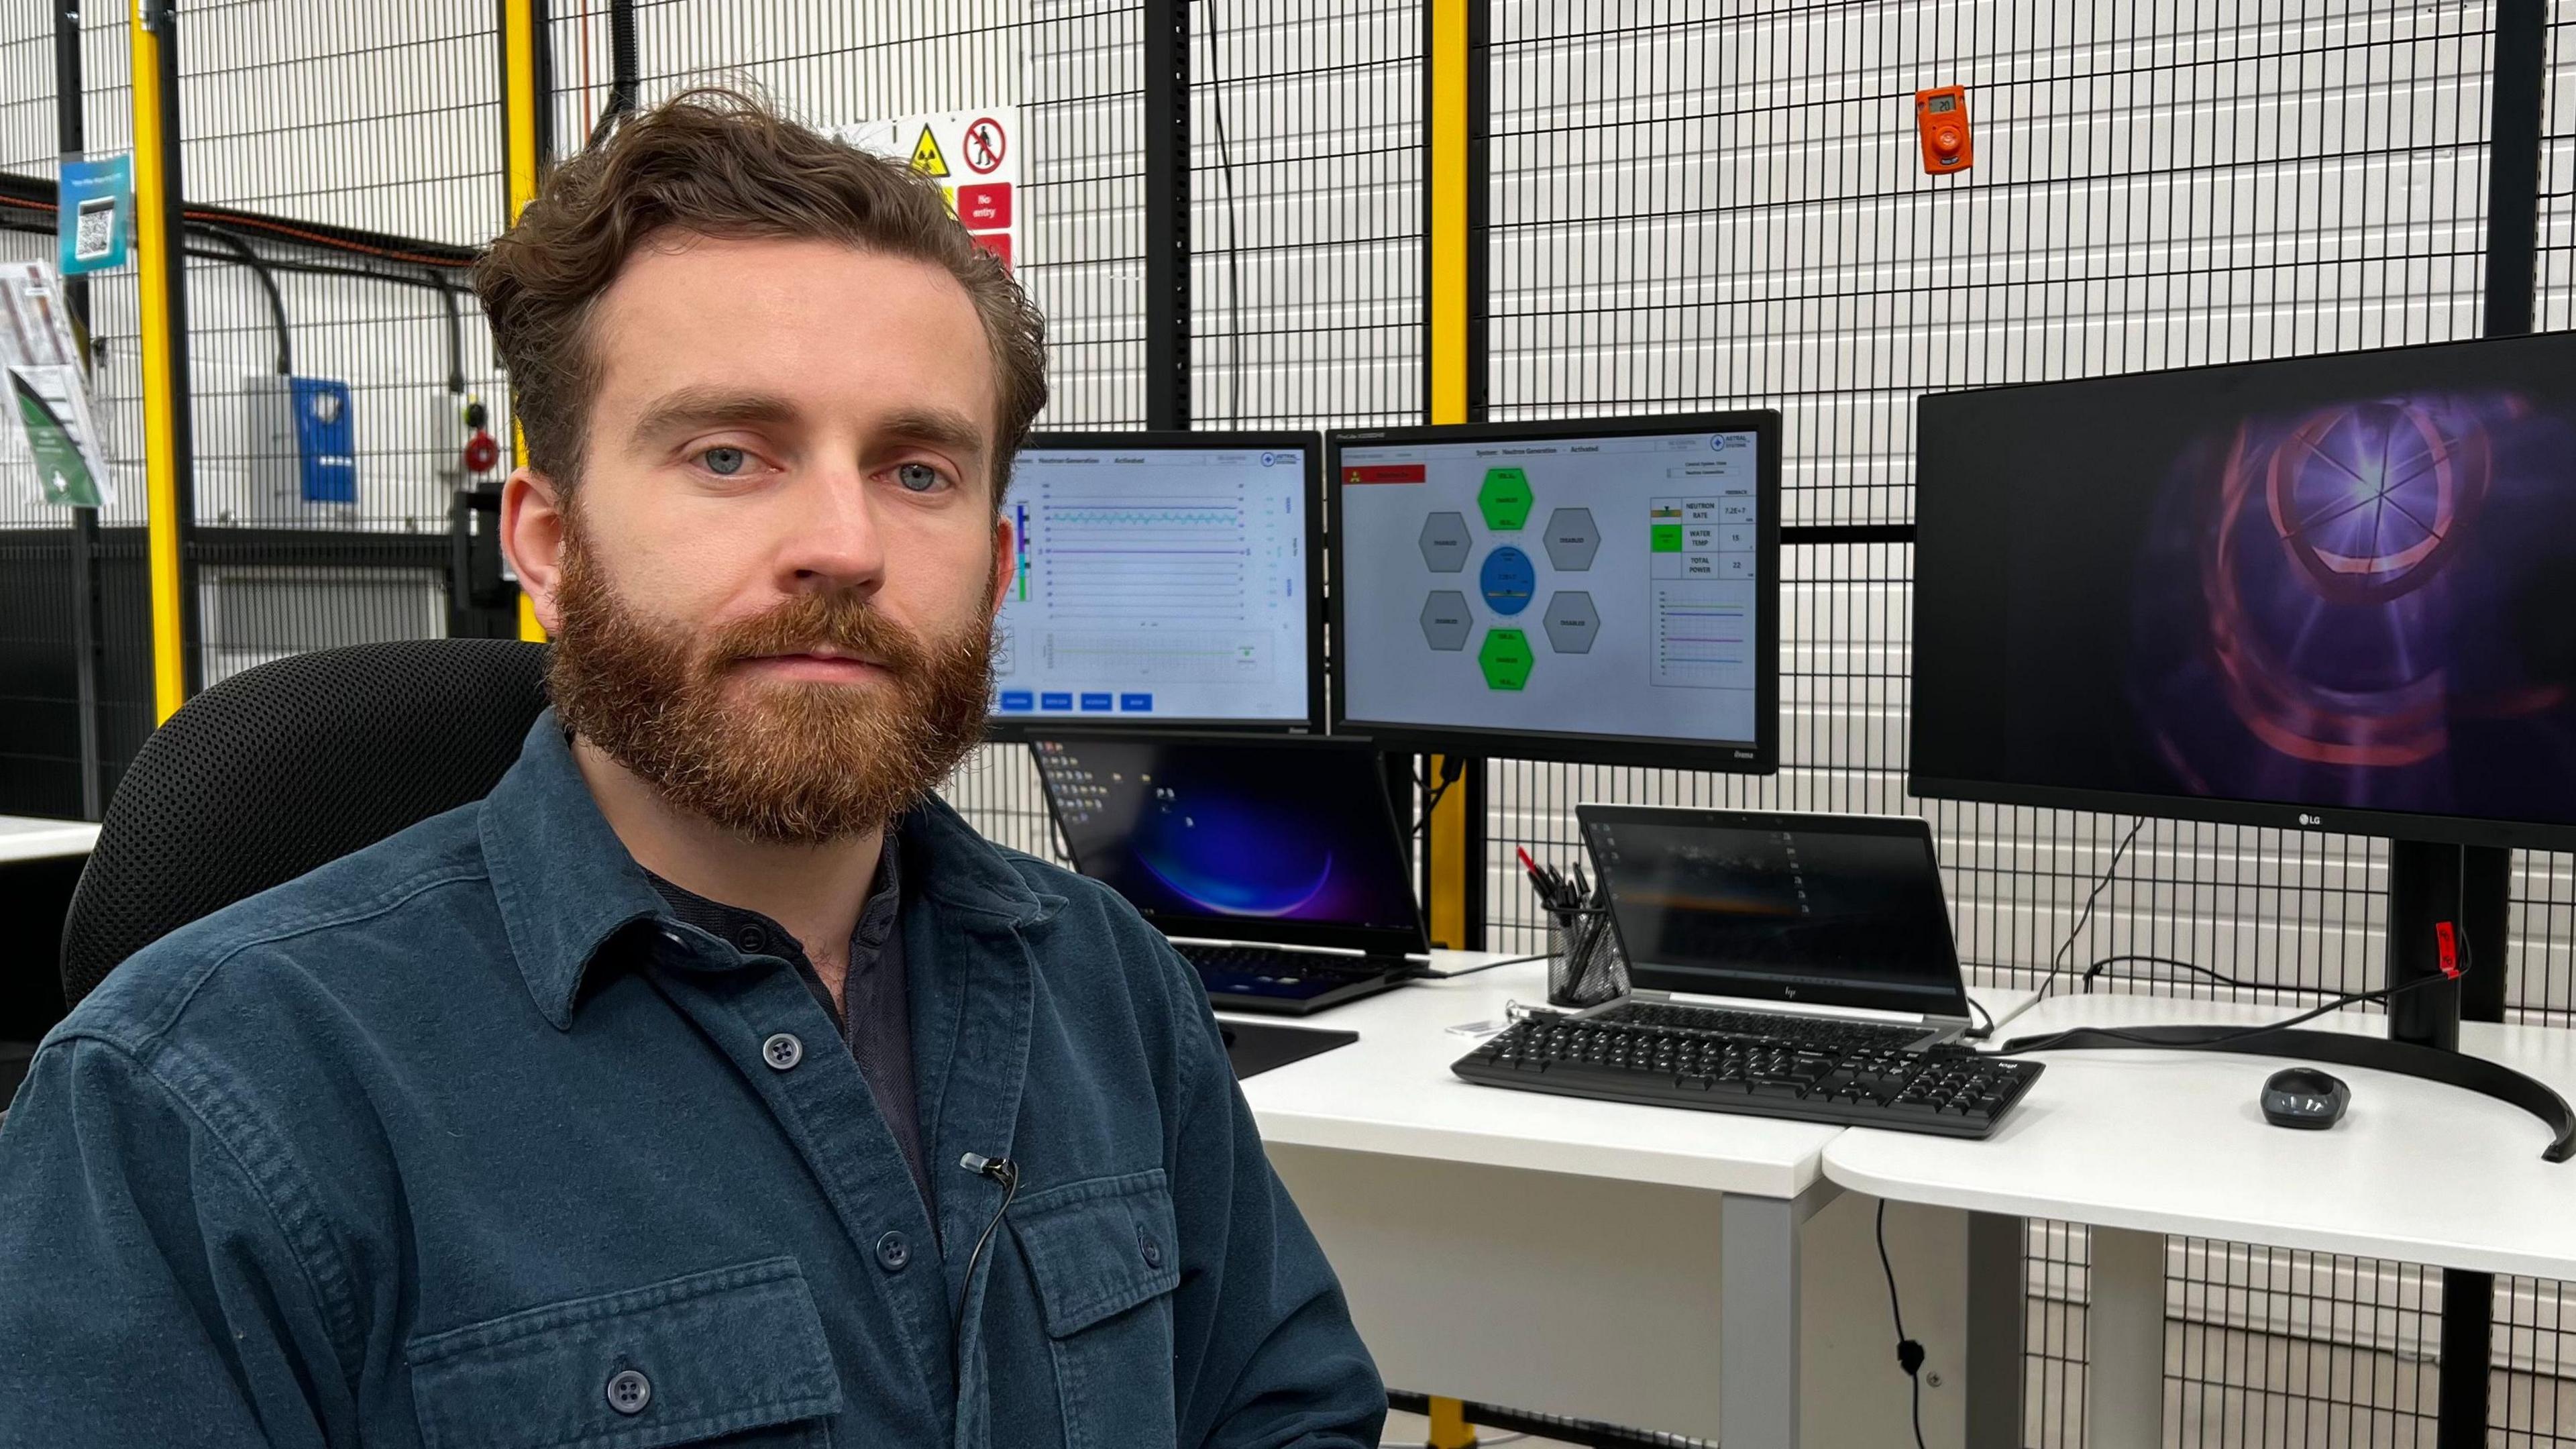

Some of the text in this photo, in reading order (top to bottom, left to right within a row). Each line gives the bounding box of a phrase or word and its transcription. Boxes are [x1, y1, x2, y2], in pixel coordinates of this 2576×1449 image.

[977, 194, 991, 205] No
[973, 208, 996, 219] entry
[2309, 816, 2320, 824] LG
[1785, 986, 1796, 999] hp
